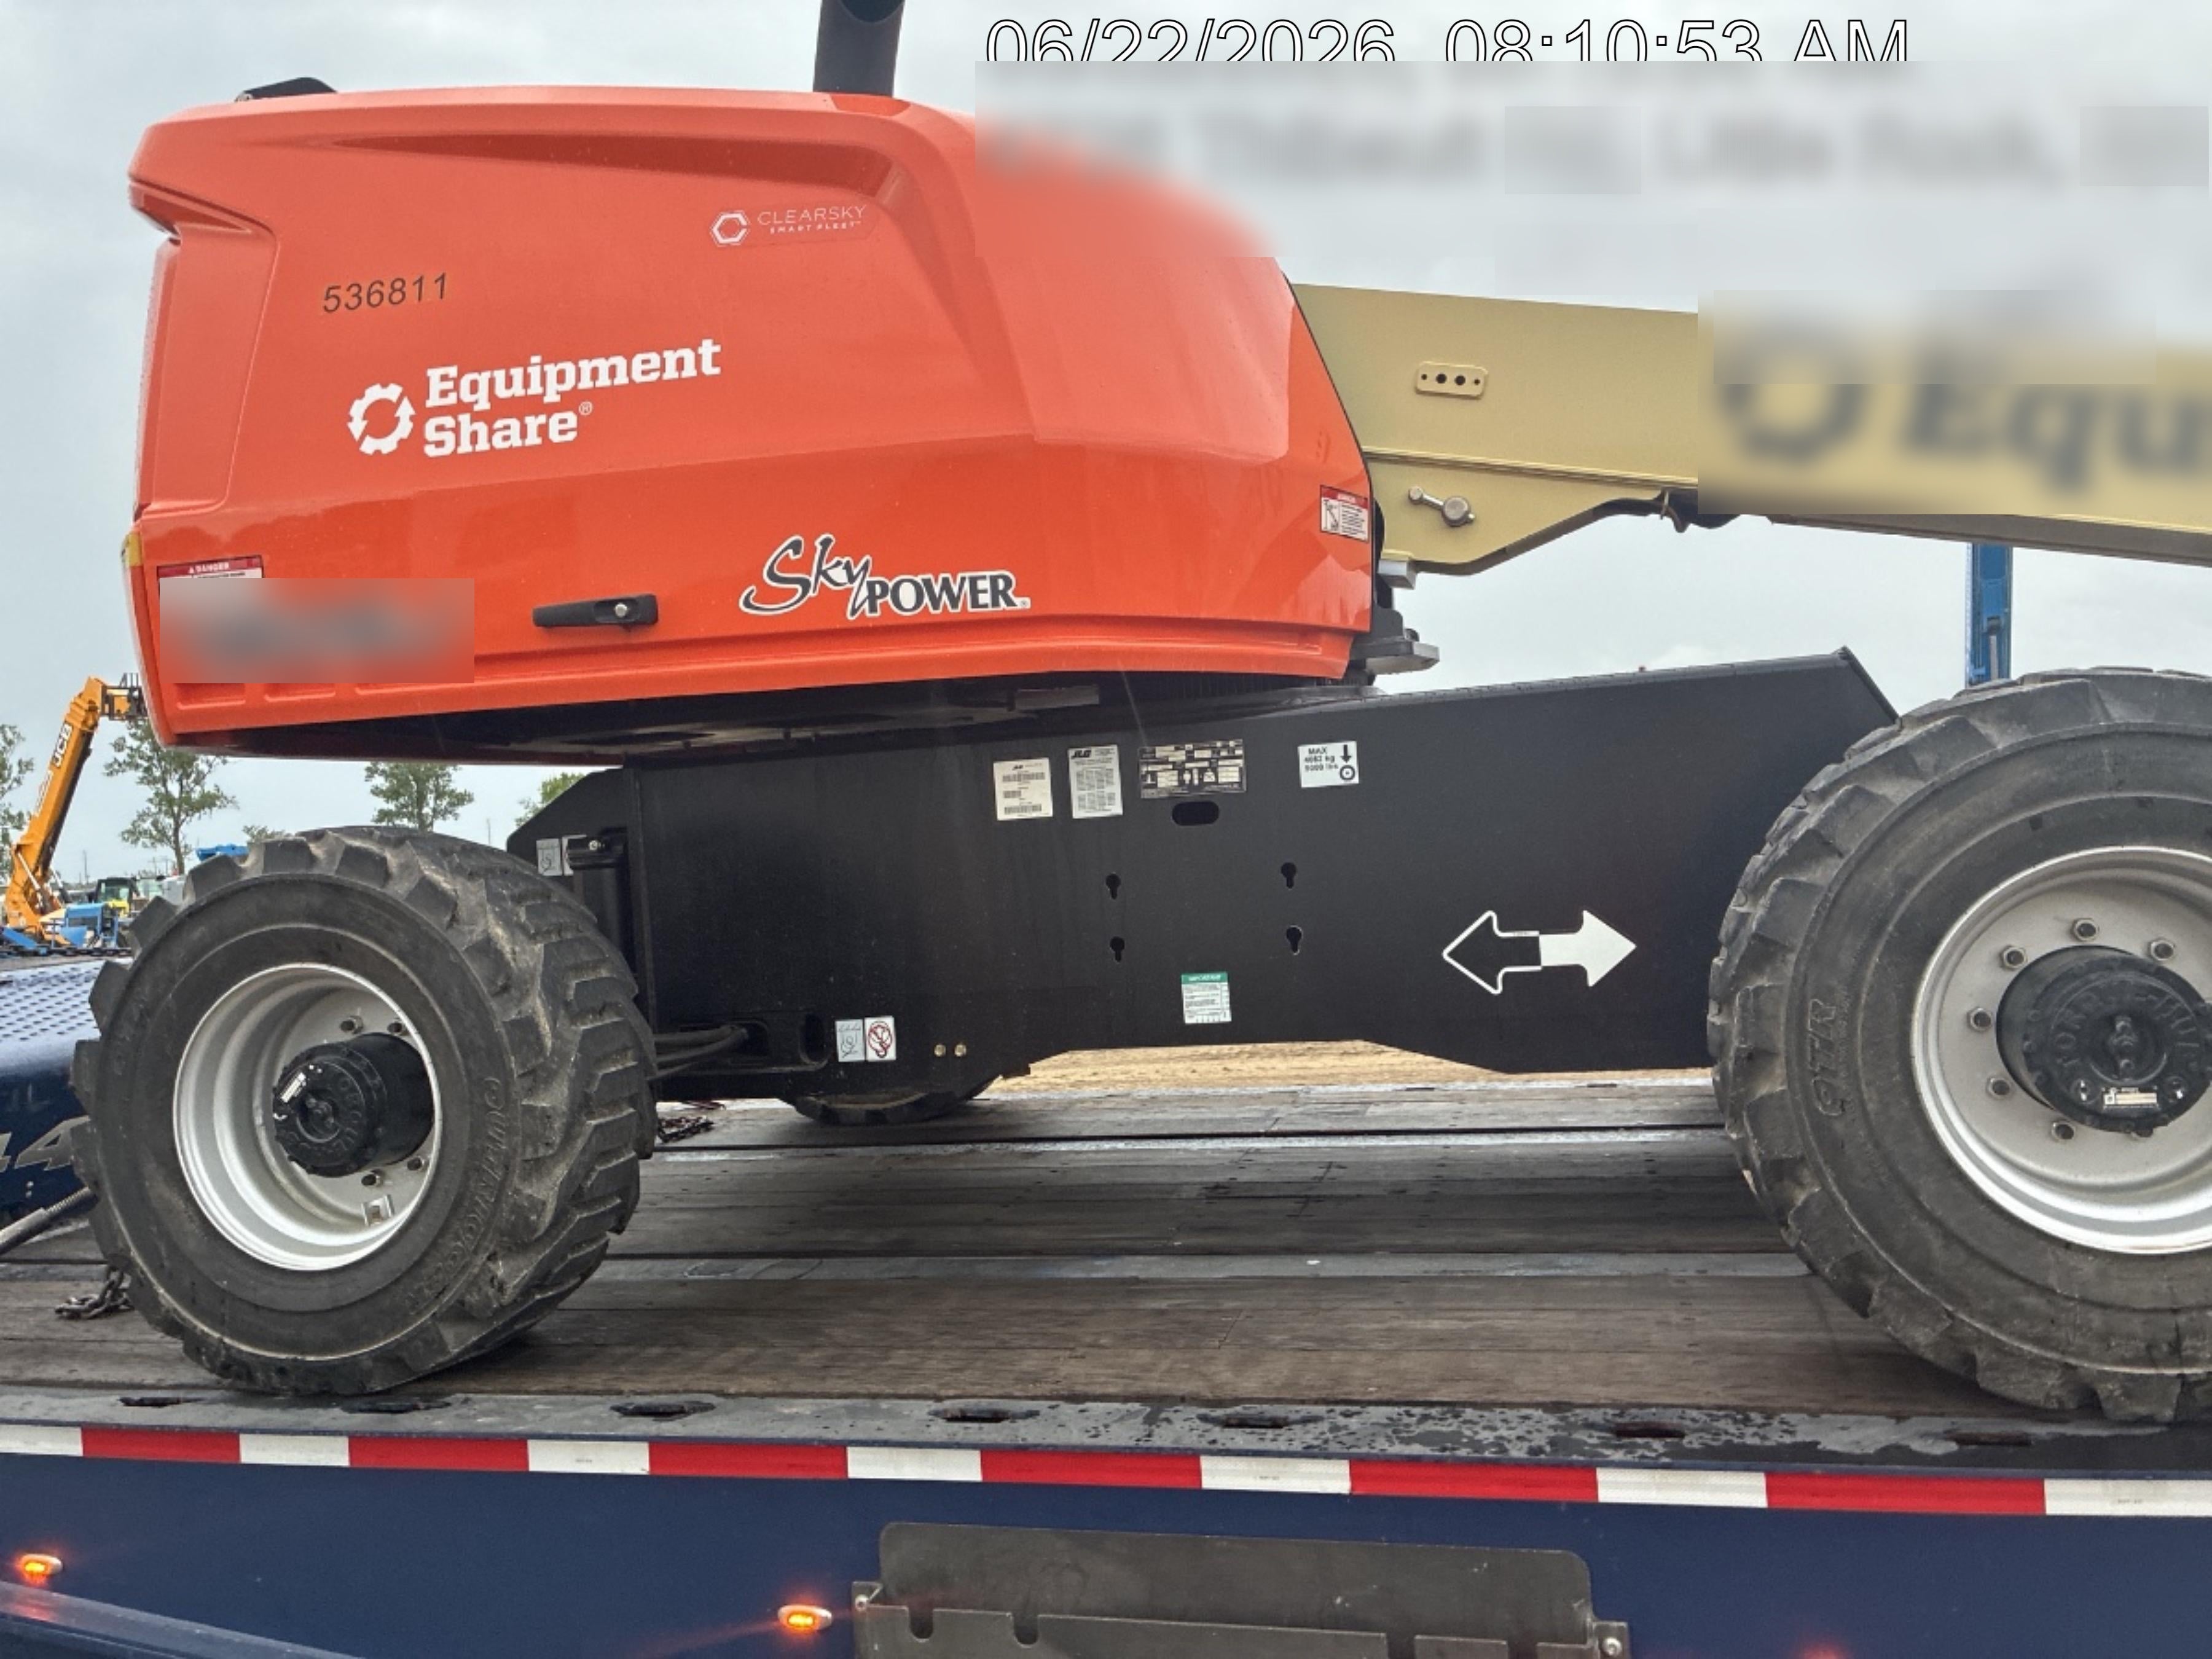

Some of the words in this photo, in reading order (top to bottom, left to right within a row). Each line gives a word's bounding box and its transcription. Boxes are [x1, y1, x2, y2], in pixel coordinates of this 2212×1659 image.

[757, 206, 867, 226] CLEARSKY
[770, 224, 812, 234] SMART
[323, 272, 447, 313] 536811
[425, 338, 721, 412] Equipment
[50, 724, 73, 767] JCB
